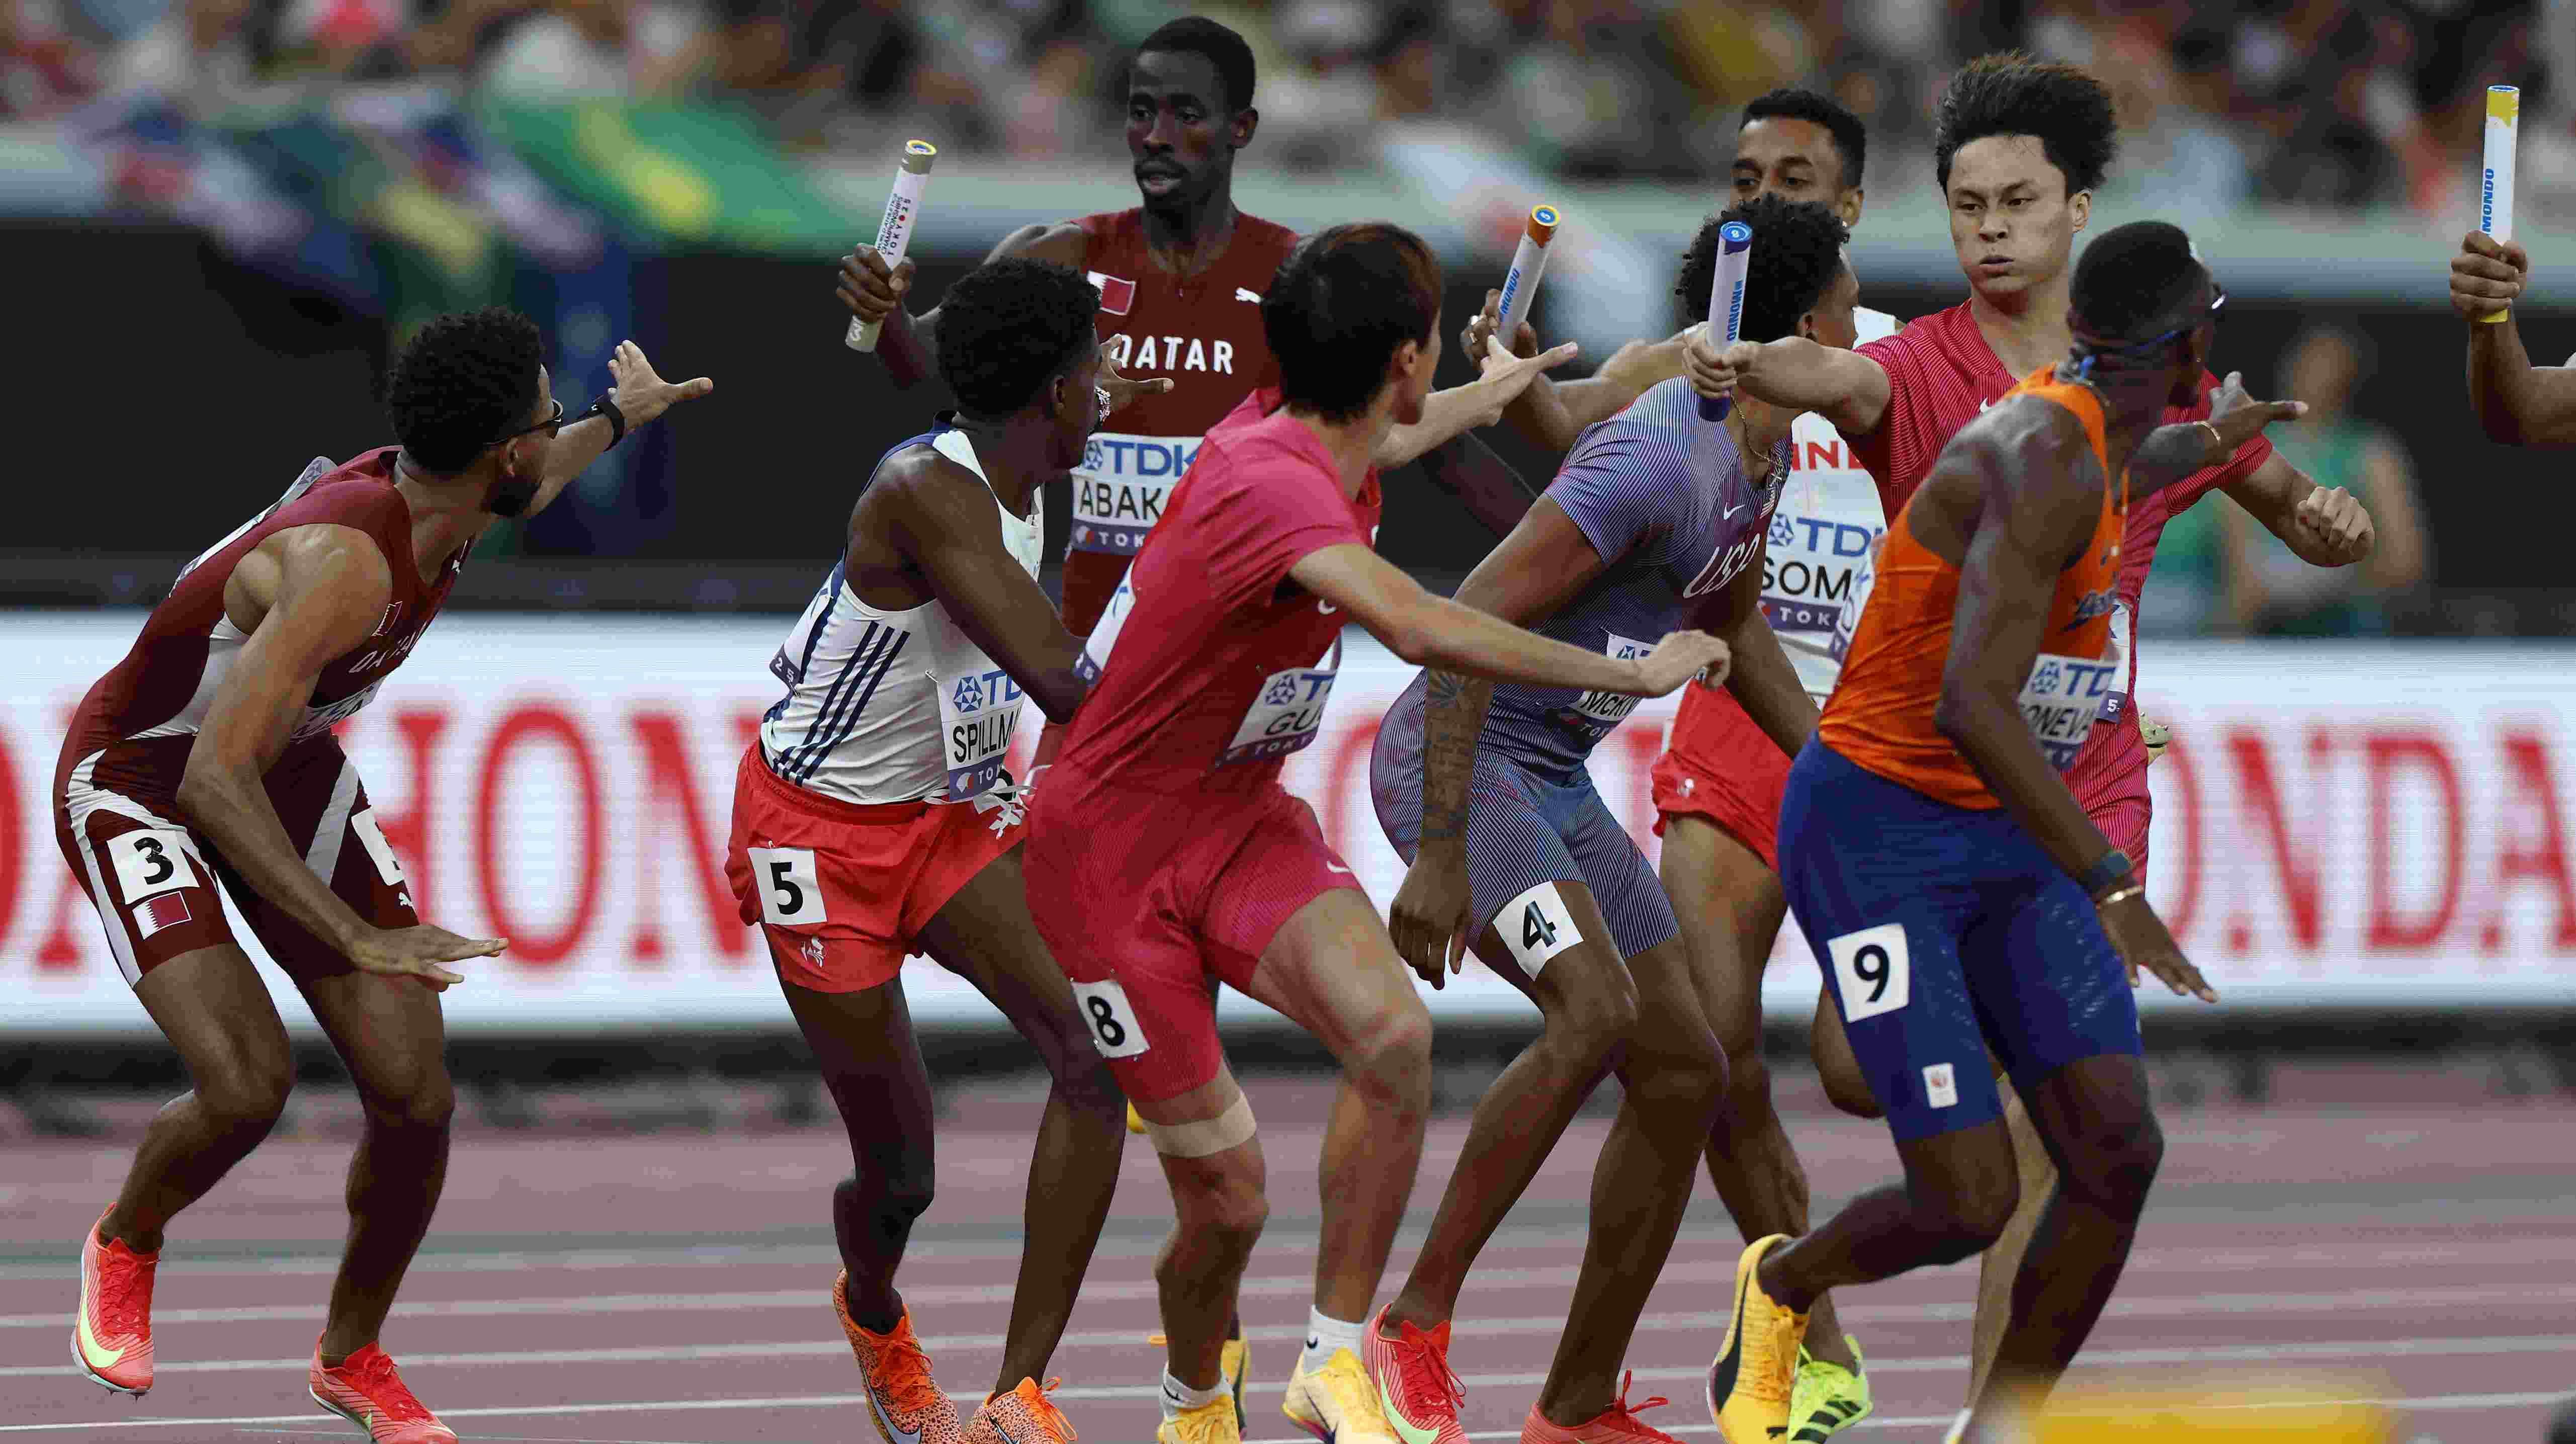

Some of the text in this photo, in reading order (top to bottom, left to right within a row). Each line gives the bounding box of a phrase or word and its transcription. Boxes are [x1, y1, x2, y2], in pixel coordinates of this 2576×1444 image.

[2481, 168, 2495, 234] MONDO
[133, 837, 174, 885] 3
[769, 861, 804, 915] 5
[1523, 900, 1557, 951] 4
[1853, 943, 1890, 1003] 9
[1087, 995, 1126, 1047] 8
